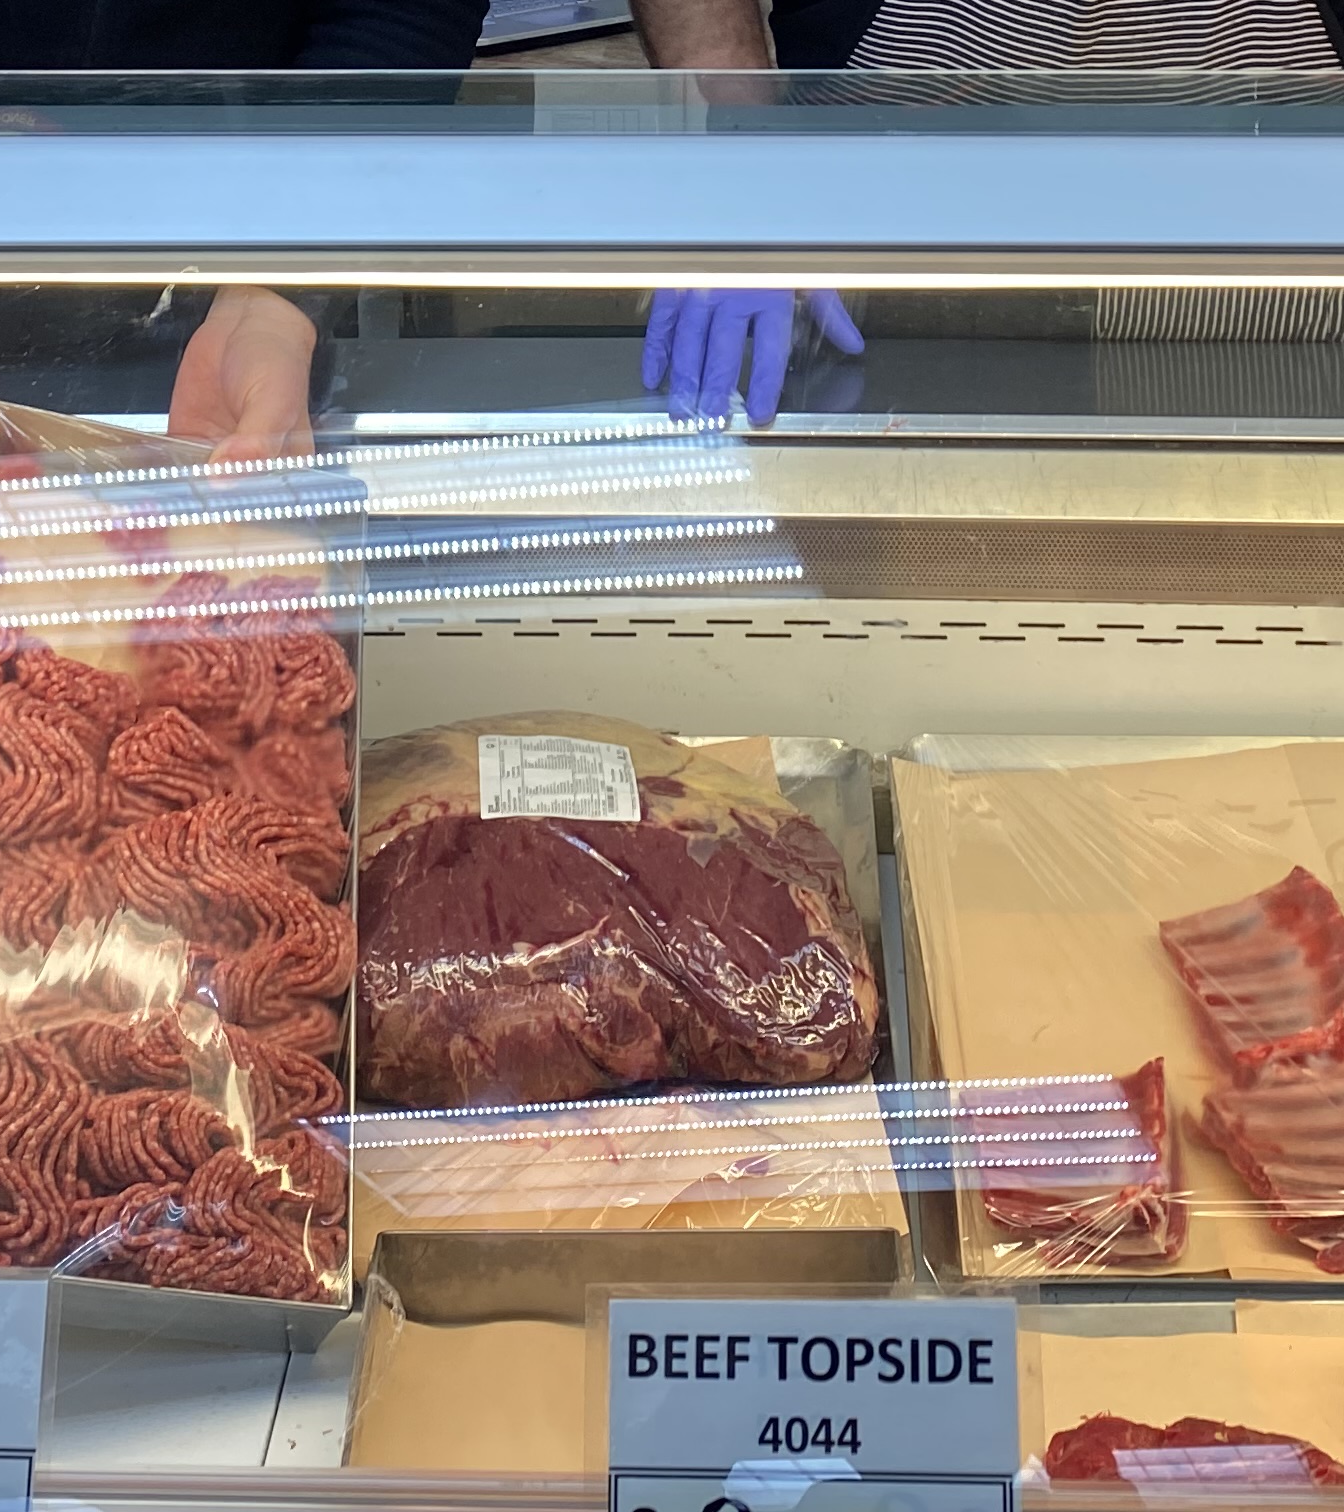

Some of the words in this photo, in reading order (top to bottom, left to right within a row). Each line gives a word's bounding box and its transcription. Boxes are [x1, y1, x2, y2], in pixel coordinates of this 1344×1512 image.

[628, 1334, 751, 1380] BEEF
[767, 1336, 995, 1385] TOPSIDE
[758, 1416, 862, 1454] 4044
